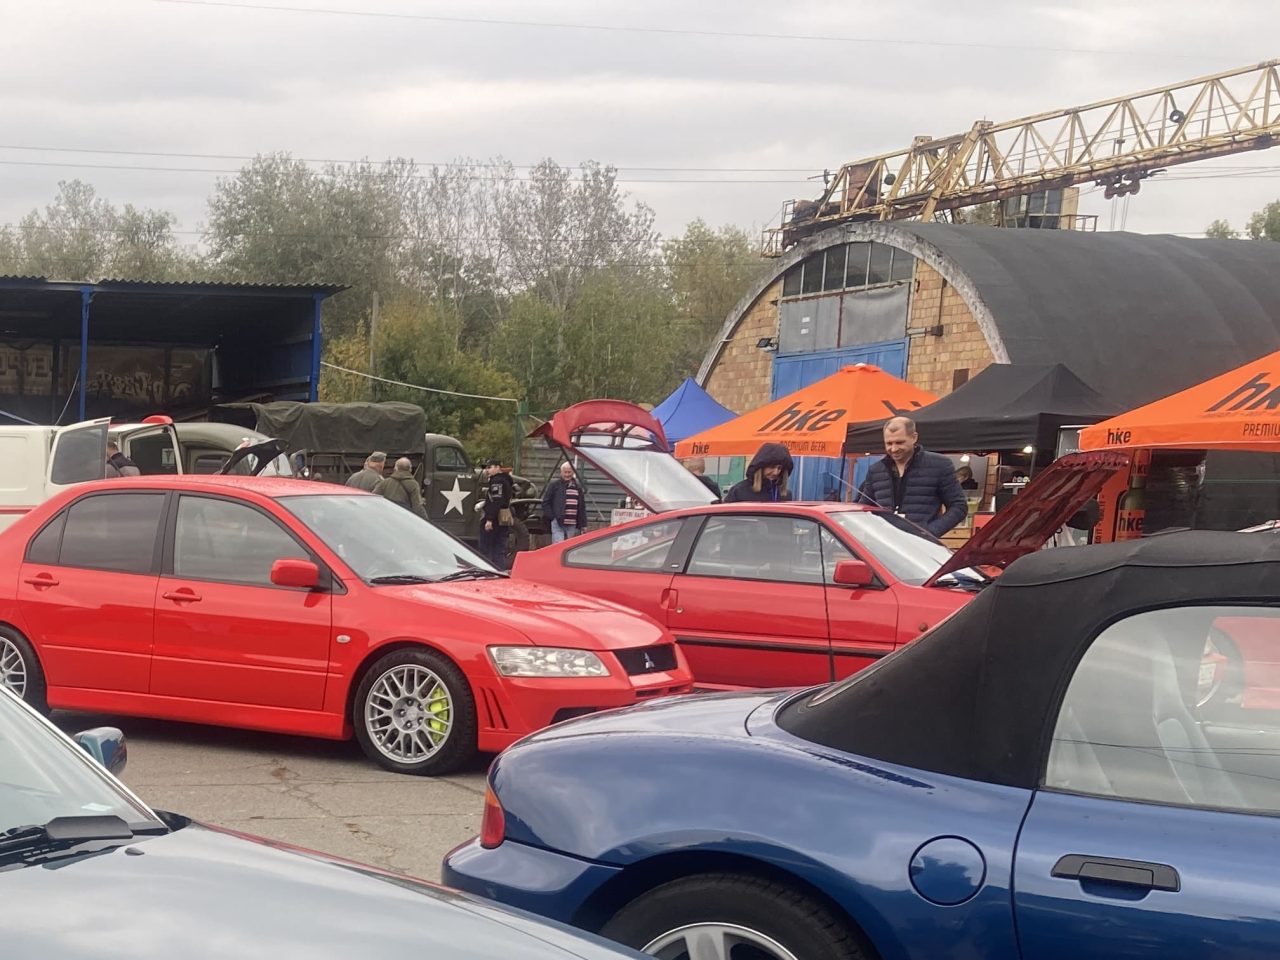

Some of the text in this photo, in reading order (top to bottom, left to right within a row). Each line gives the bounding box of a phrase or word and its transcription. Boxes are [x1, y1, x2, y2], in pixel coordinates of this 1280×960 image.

[757, 400, 847, 432] hike
[1107, 428, 1132, 445] hike
[691, 441, 710, 455] hike
